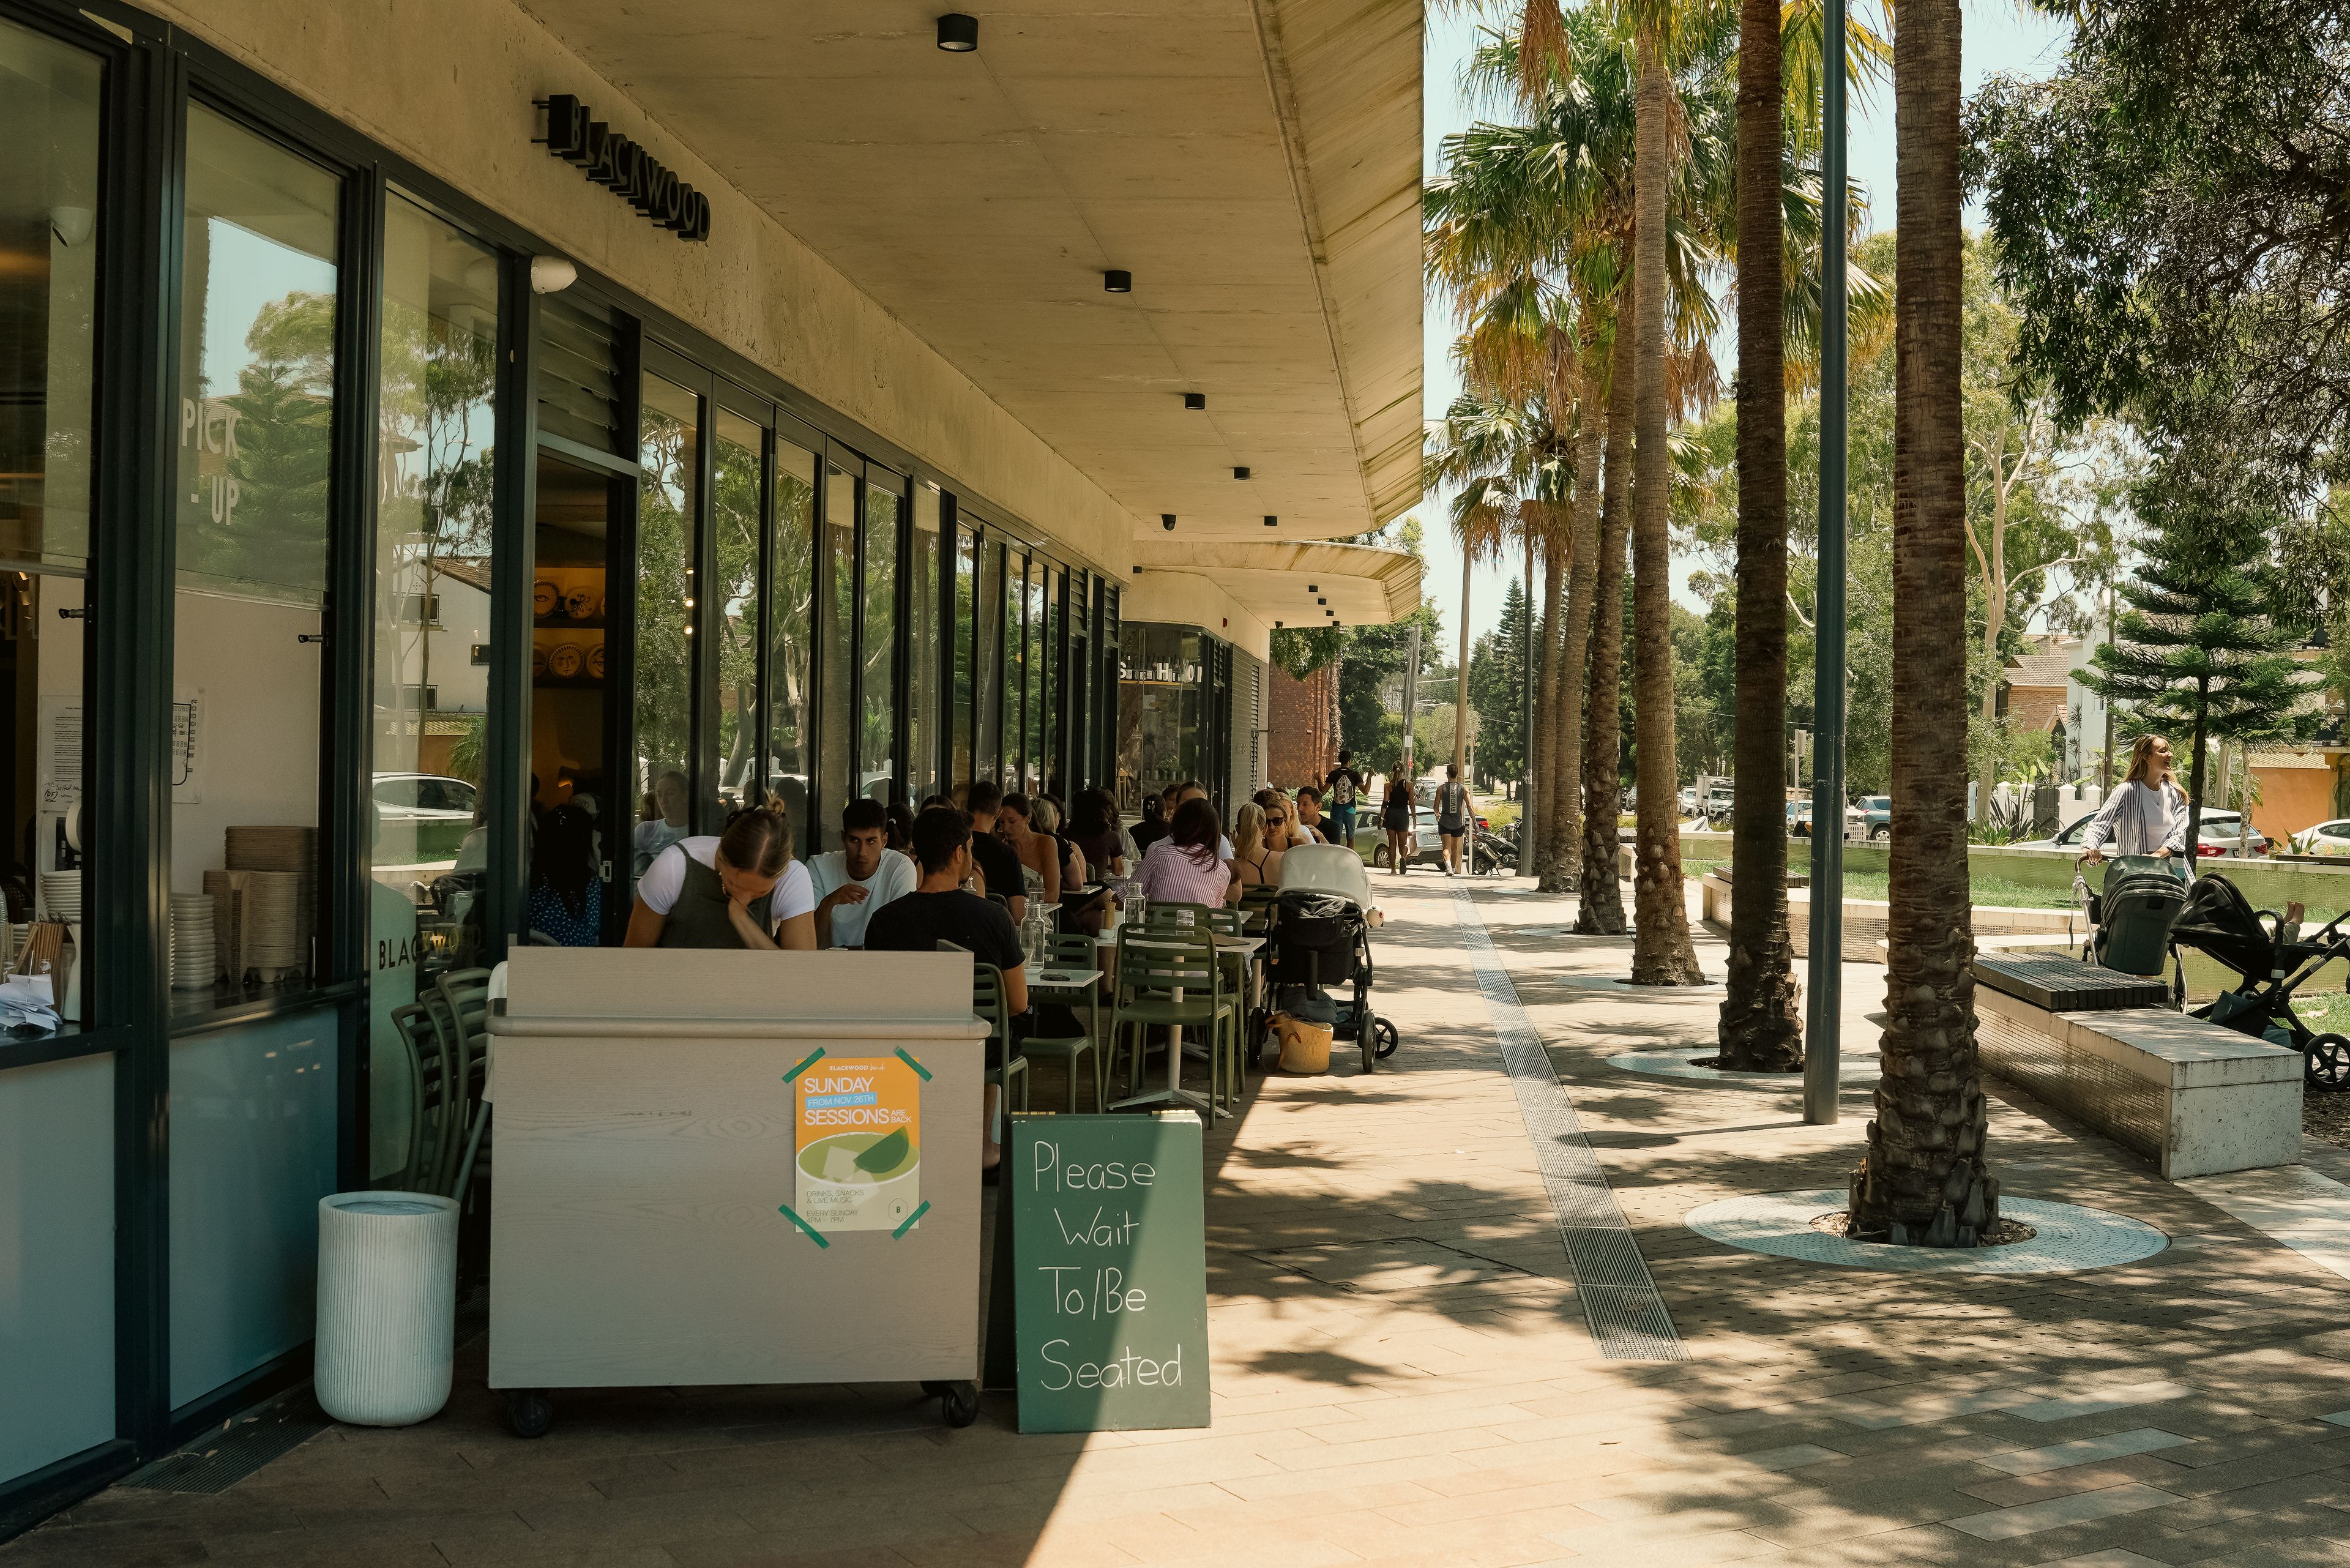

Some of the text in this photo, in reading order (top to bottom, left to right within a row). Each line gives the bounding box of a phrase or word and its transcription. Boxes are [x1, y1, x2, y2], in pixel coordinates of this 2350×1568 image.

[548, 94, 711, 242] BLACKWOOD
[182, 398, 239, 459] PICK
[211, 476, 239, 526] UP
[379, 923, 481, 970] BLACKWOD
[804, 1077, 875, 1094] SUNDAY
[807, 1098, 832, 1107] FROM
[834, 1096, 851, 1105] NOV
[804, 1108, 889, 1126] SESSIONS
[1034, 1140, 1156, 1192] Please
[1053, 1206, 1140, 1246] Wait
[1039, 1266, 1147, 1321] To/Be
[1040, 1338, 1182, 1391] Seated
